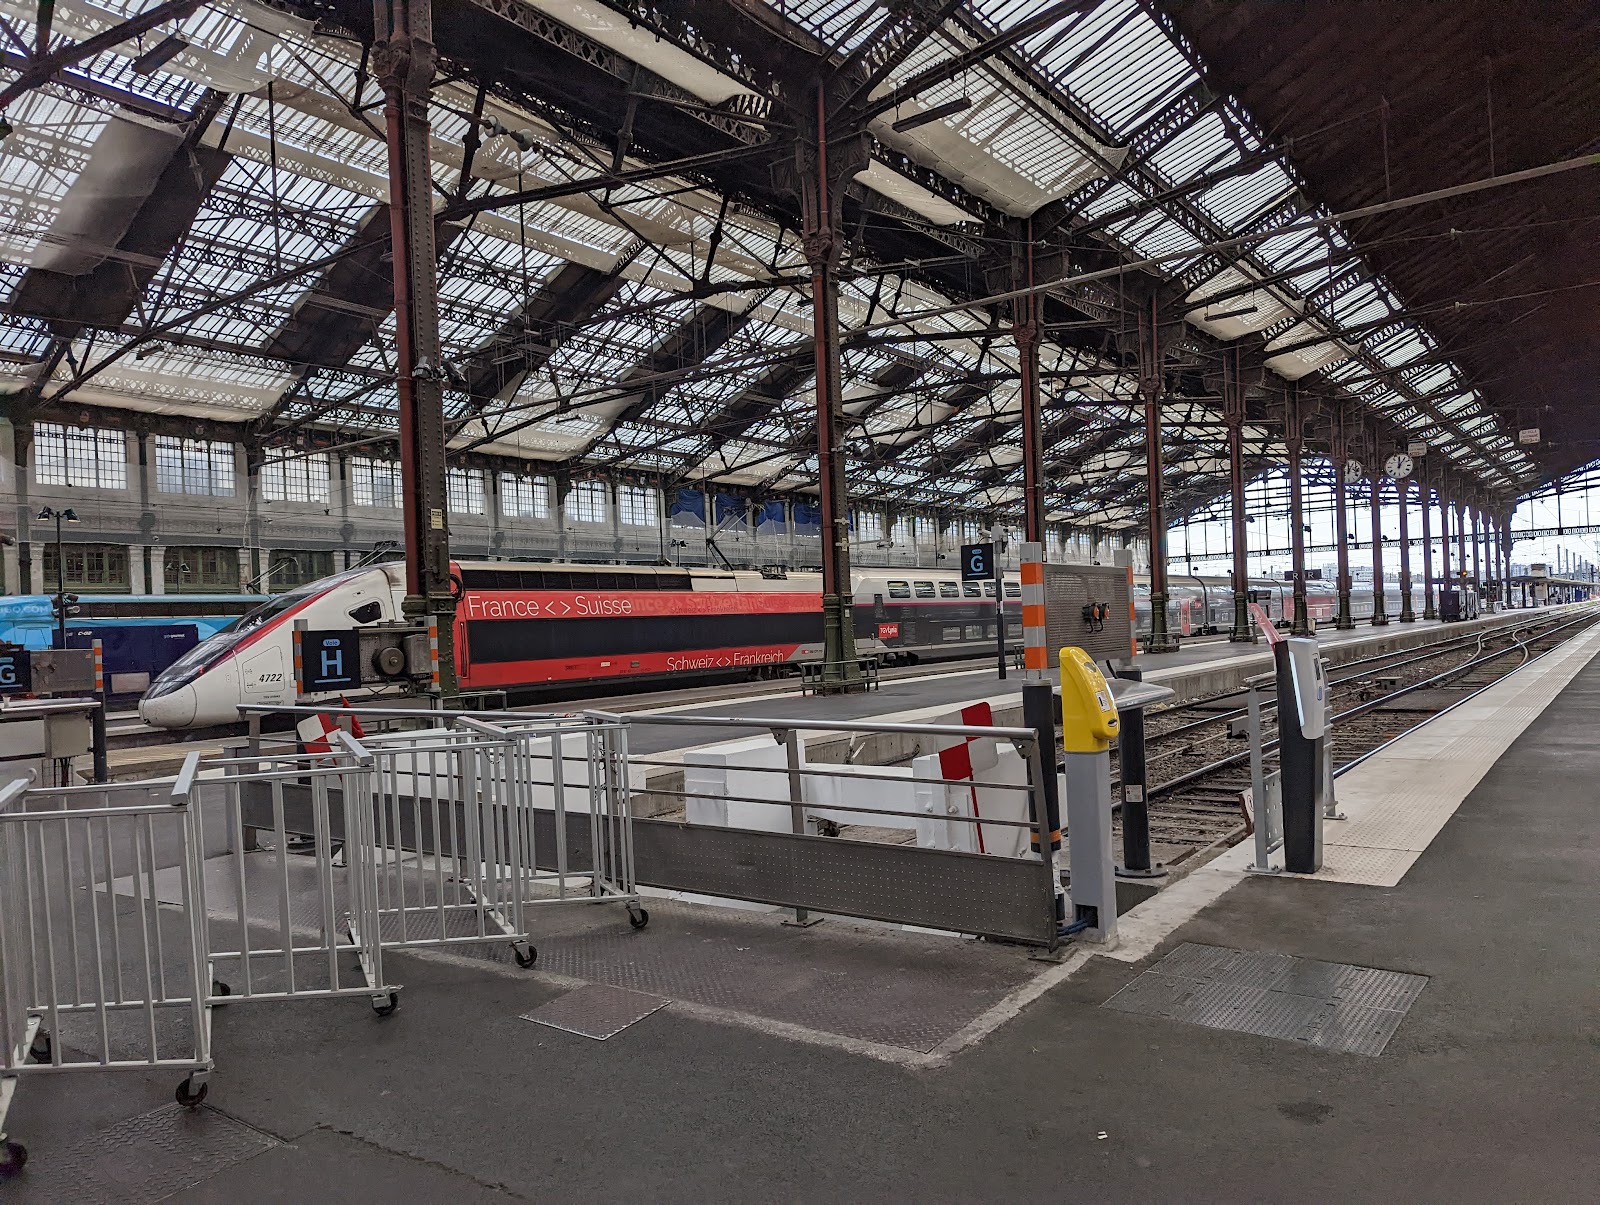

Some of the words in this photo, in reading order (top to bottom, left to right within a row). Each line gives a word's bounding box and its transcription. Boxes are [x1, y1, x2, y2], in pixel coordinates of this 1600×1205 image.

[970, 555, 984, 572] G
[467, 595, 540, 617] France
[575, 594, 632, 617] Suisse
[321, 649, 343, 677] H
[666, 654, 715, 672] Schweiz
[733, 650, 784, 666] Frankreich
[0, 664, 17, 684] G
[258, 673, 283, 683] 4722
